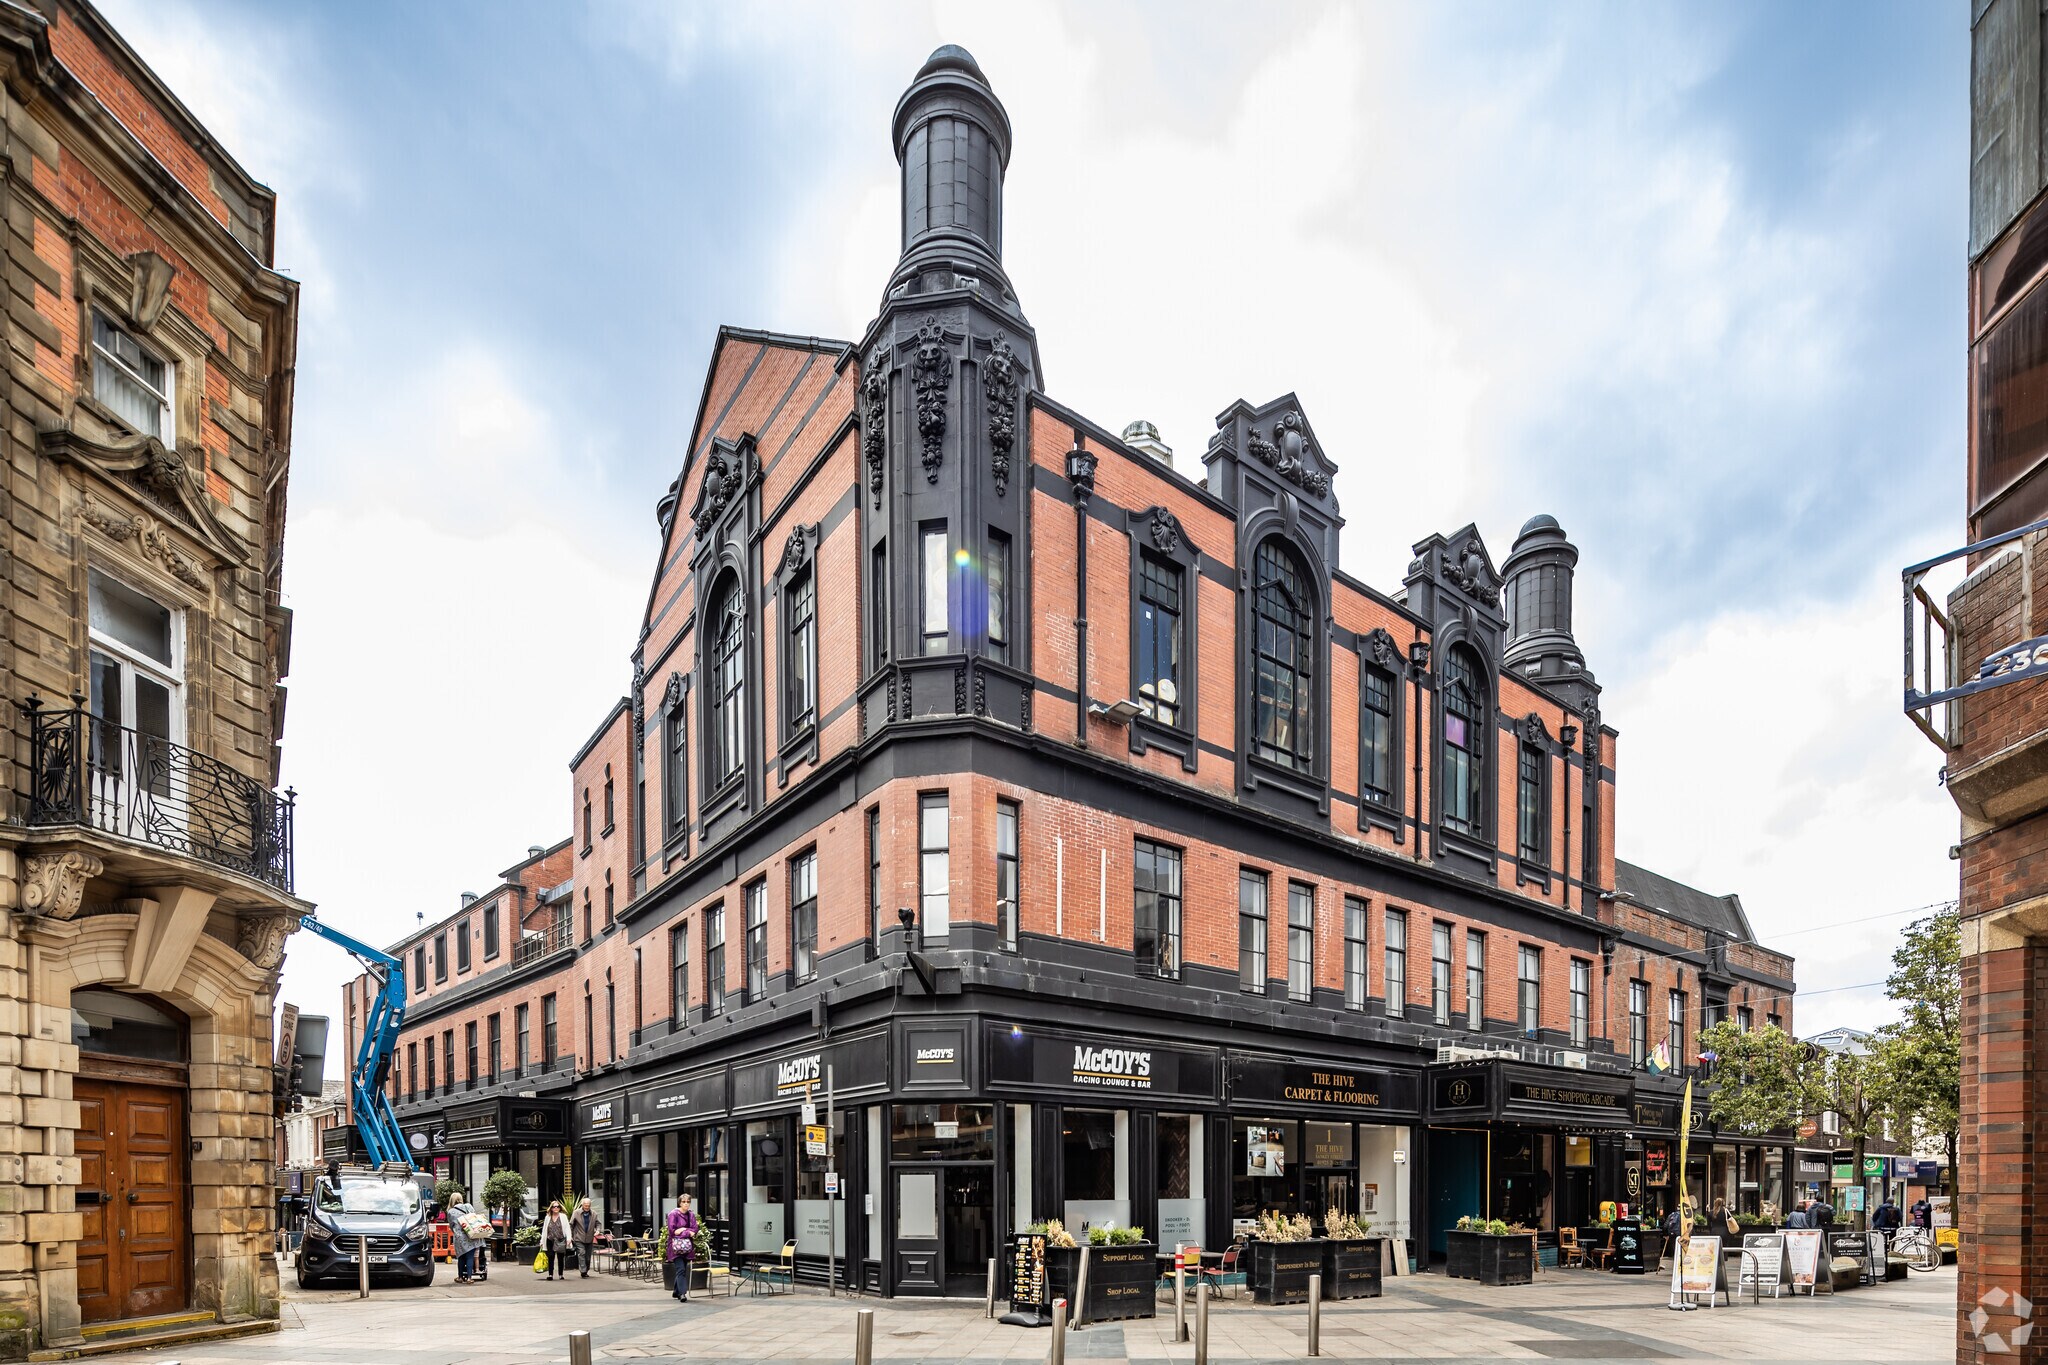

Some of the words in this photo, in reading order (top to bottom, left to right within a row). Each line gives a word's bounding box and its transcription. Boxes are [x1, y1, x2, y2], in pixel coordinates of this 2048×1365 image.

[917, 1048, 954, 1059] McCOY'S
[1073, 1045, 1151, 1076] McCOY'S
[778, 1054, 821, 1085] McCOY'S
[1073, 1075, 1100, 1084] RACING
[1102, 1078, 1129, 1087] LOUNGE
[1312, 1072, 1331, 1086] THE
[1333, 1074, 1355, 1088] HIVE
[1284, 1086, 1323, 1101] CARPET
[1324, 1090, 1332, 1101] &
[1333, 1091, 1379, 1105] FLOORING
[1455, 1085, 1464, 1095] H
[1526, 1086, 1540, 1099] THE
[1541, 1088, 1557, 1101] HIVE
[1558, 1091, 1590, 1104] SHOPPING
[1591, 1095, 1616, 1106] ARCADE
[1315, 1144, 1328, 1152] THE
